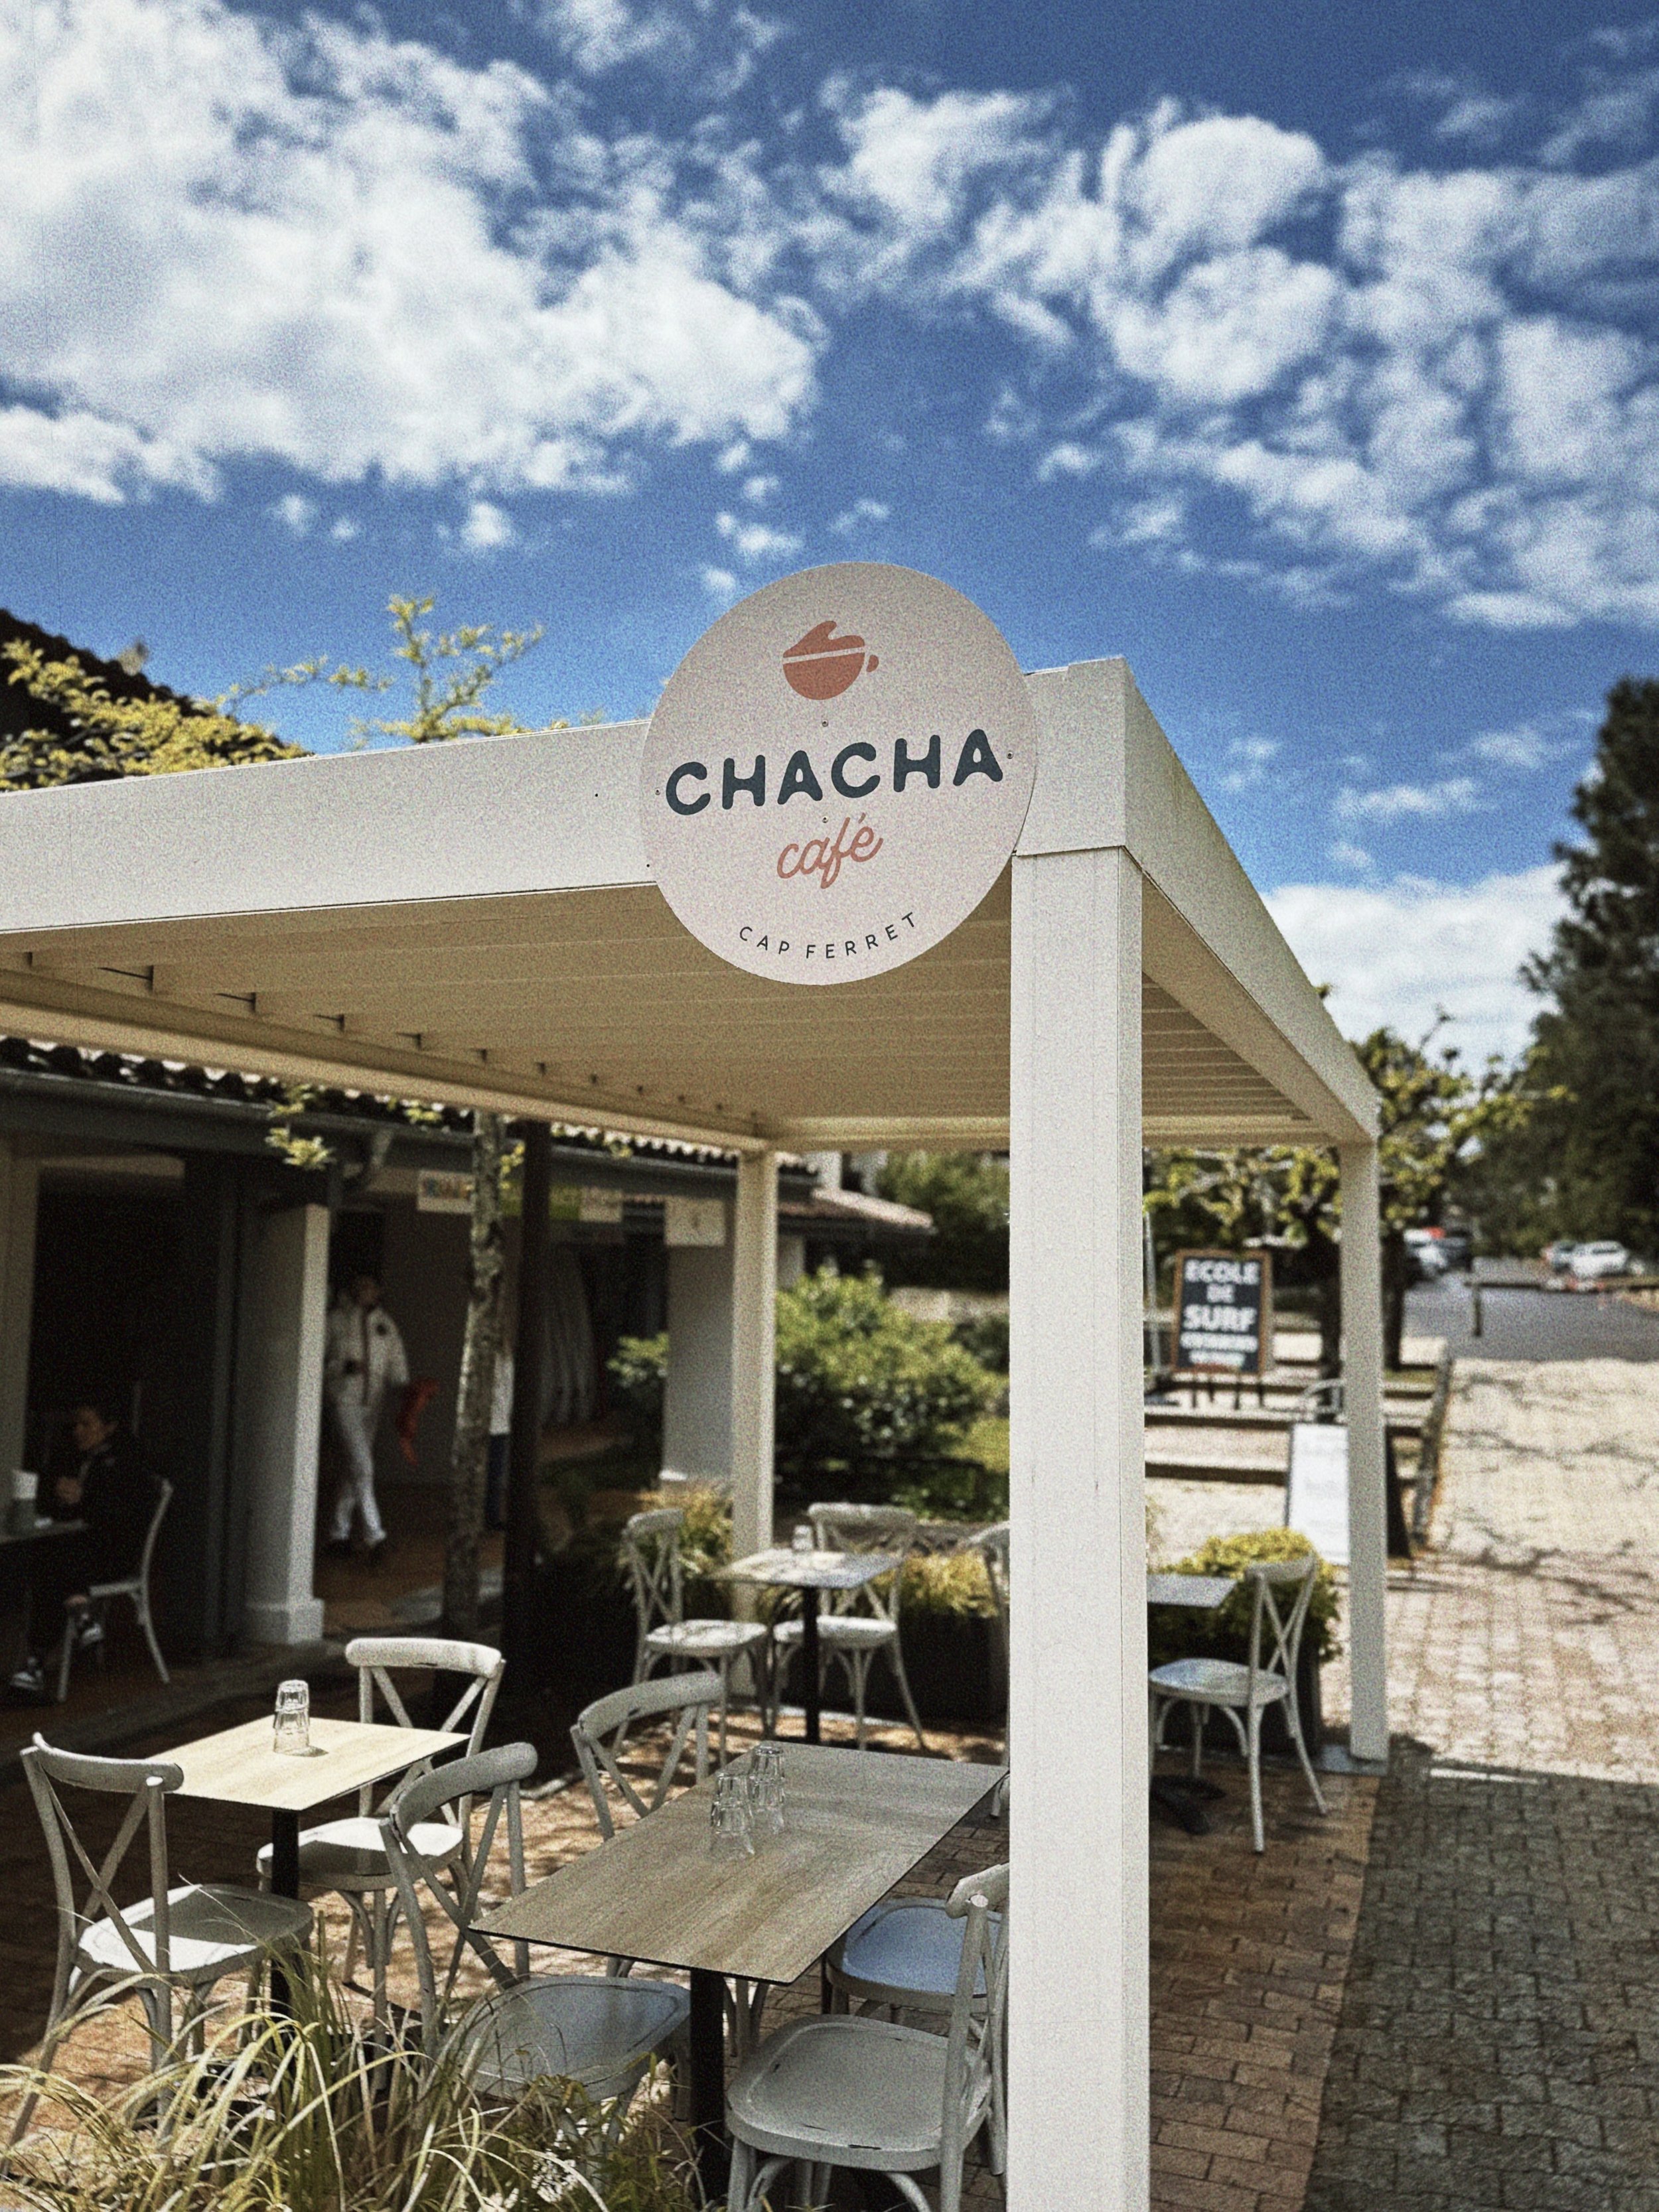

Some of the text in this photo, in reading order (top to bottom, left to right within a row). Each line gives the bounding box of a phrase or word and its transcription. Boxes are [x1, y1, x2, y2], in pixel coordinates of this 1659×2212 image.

[666, 728, 1003, 815] CHACHA
[776, 813, 883, 889] café
[739, 912, 915, 959] CAP FERRET
[1185, 1259, 1260, 1285] ECOLE
[1183, 1304, 1257, 1332] SURF
